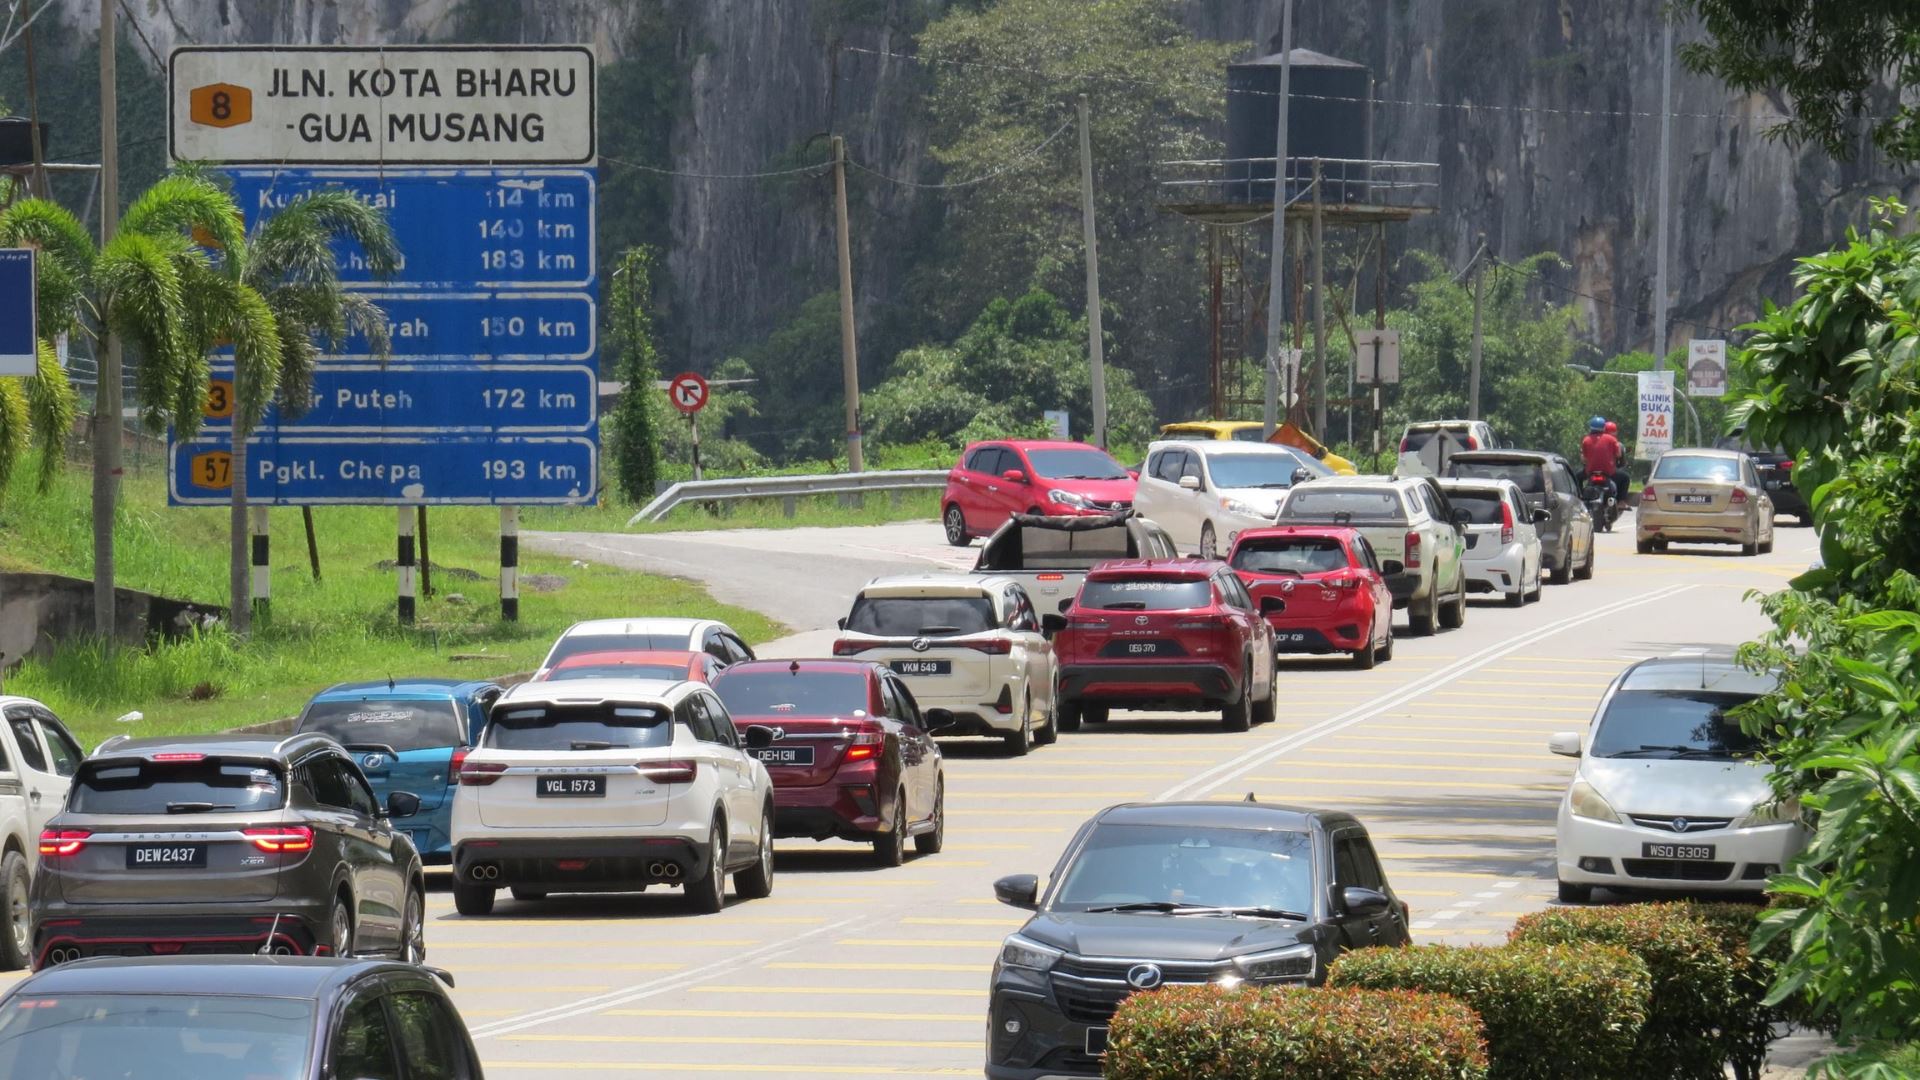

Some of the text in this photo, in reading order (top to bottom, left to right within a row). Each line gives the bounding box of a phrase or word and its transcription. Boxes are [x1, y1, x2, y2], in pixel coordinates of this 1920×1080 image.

[267, 68, 576, 97] JLN. KOTA BHARU
[211, 91, 232, 120] 8
[388, 112, 545, 143] MUSANG
[538, 189, 575, 208] km
[479, 219, 575, 239] 140 km
[481, 250, 575, 270] 183 km
[481, 316, 576, 337] 150 km
[209, 385, 226, 411] 3
[337, 388, 412, 409] Puteh
[482, 388, 576, 409] 172 km
[1640, 393, 1671, 403] KLINIK
[1640, 402, 1672, 413] BUKA
[1646, 413, 1666, 427] 24
[1642, 428, 1668, 438] JAM
[205, 458, 230, 482] 57
[259, 460, 421, 484] Pgkl. Chepa
[482, 459, 576, 480] 193 km
[902, 662, 937, 673] VKM 549
[758, 750, 796, 761] DEH 1311
[546, 779, 596, 792] VGL 1573
[1677, 846, 1710, 859] 6309
